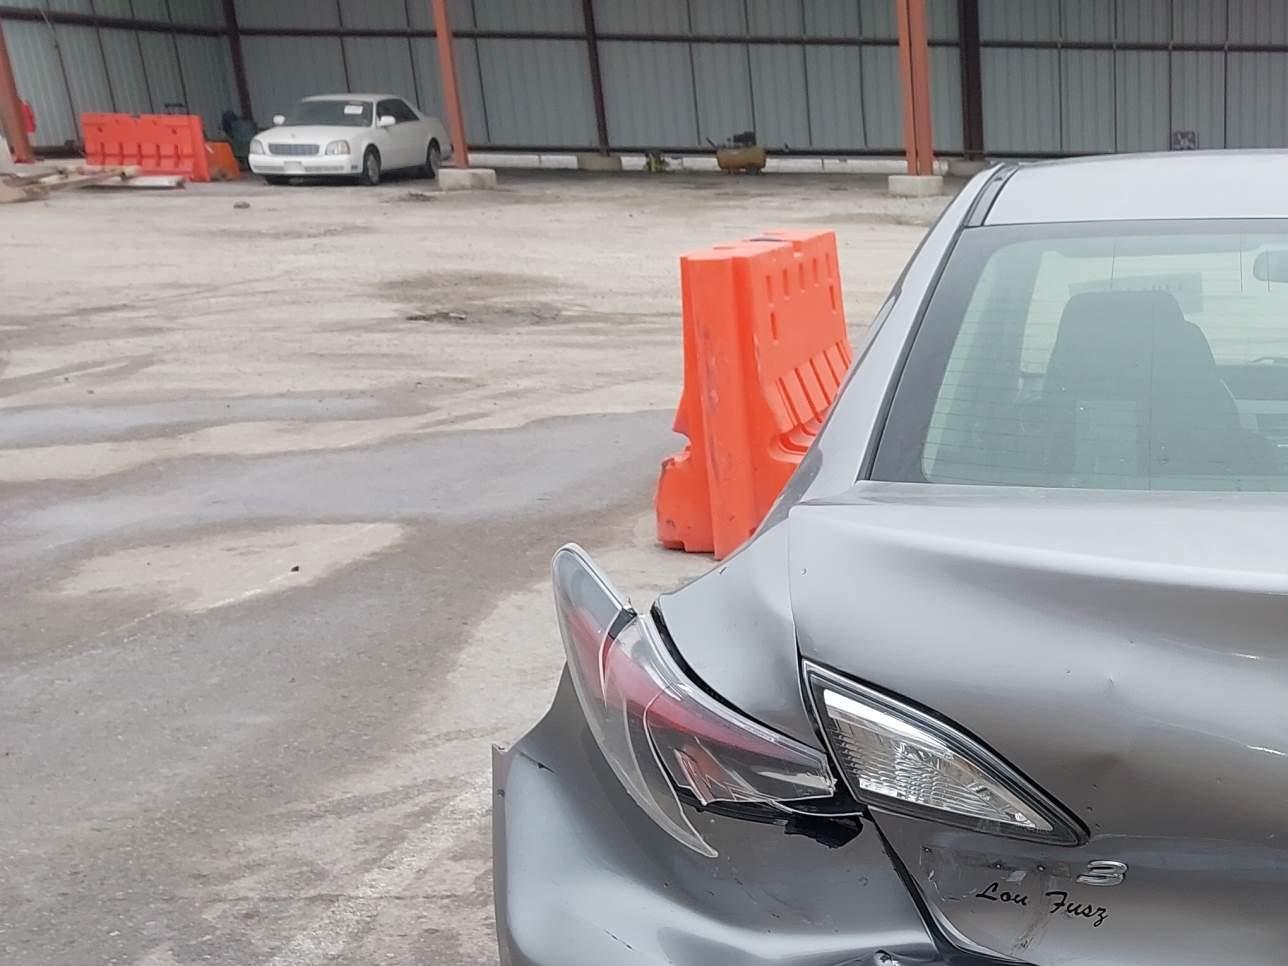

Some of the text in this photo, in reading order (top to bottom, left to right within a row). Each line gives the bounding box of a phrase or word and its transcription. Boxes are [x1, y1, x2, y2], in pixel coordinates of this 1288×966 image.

[1076, 860, 1129, 887] 3
[975, 882, 1110, 927] Lou Fusz
